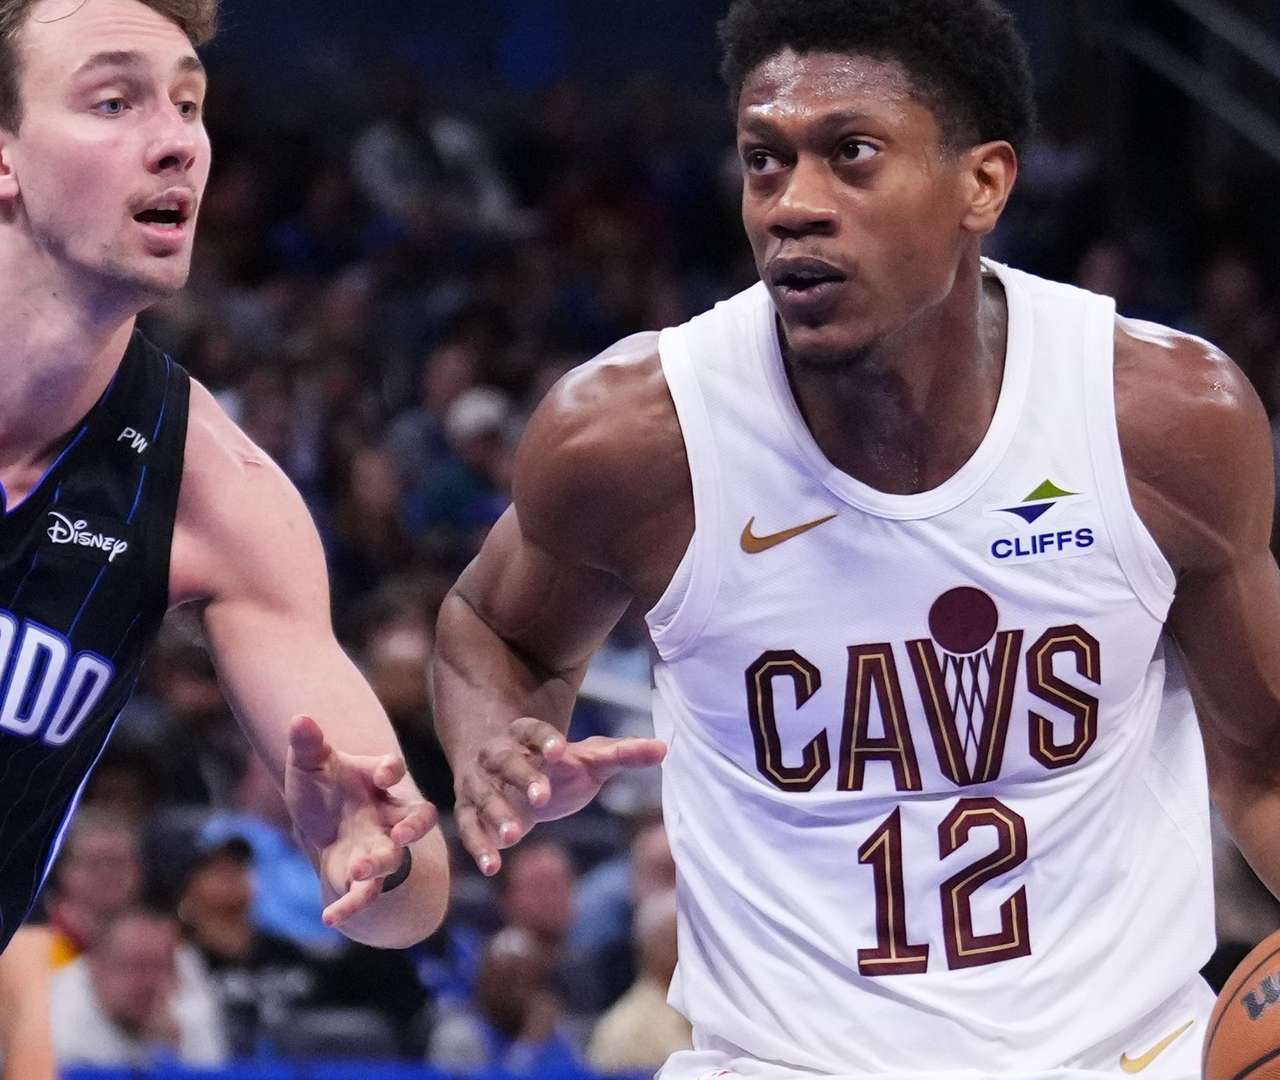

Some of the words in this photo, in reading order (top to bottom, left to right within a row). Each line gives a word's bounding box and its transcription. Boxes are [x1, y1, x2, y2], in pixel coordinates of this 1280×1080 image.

[117, 426, 148, 454] PW
[990, 527, 1095, 560] CLIFFS
[745, 624, 1102, 792] CAVS
[857, 796, 1032, 976] 12
